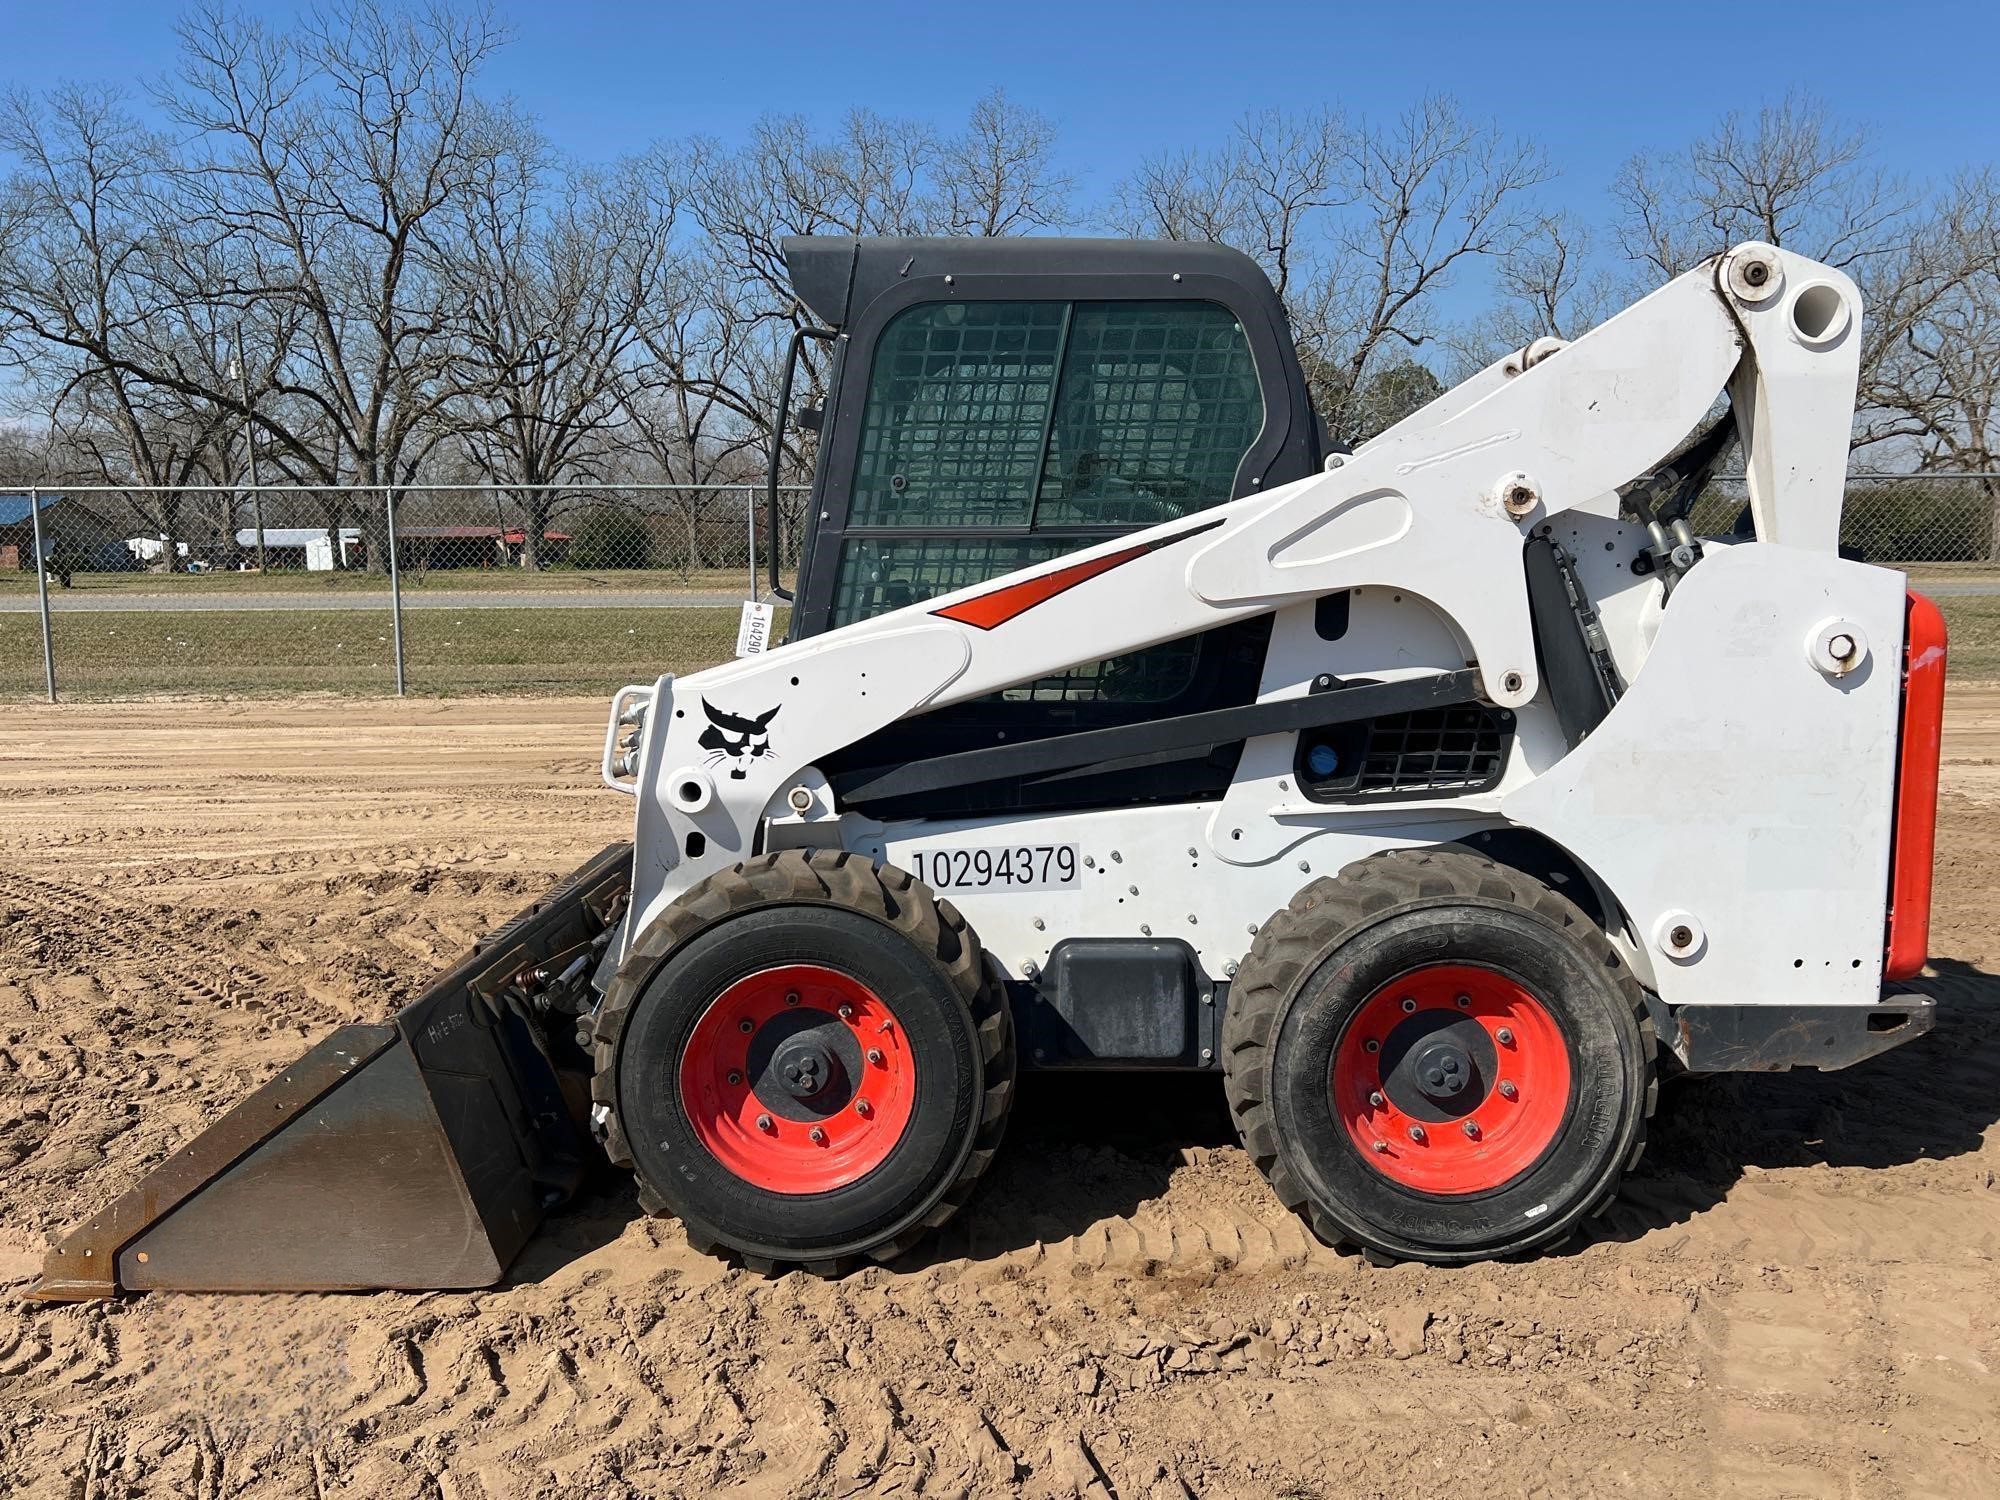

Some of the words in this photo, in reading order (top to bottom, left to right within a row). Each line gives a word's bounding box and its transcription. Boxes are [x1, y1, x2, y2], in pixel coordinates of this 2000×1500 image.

[747, 616, 765, 654] 164290
[913, 845, 1075, 888] 10294379
[1582, 1060, 1616, 1149] MAGNA
